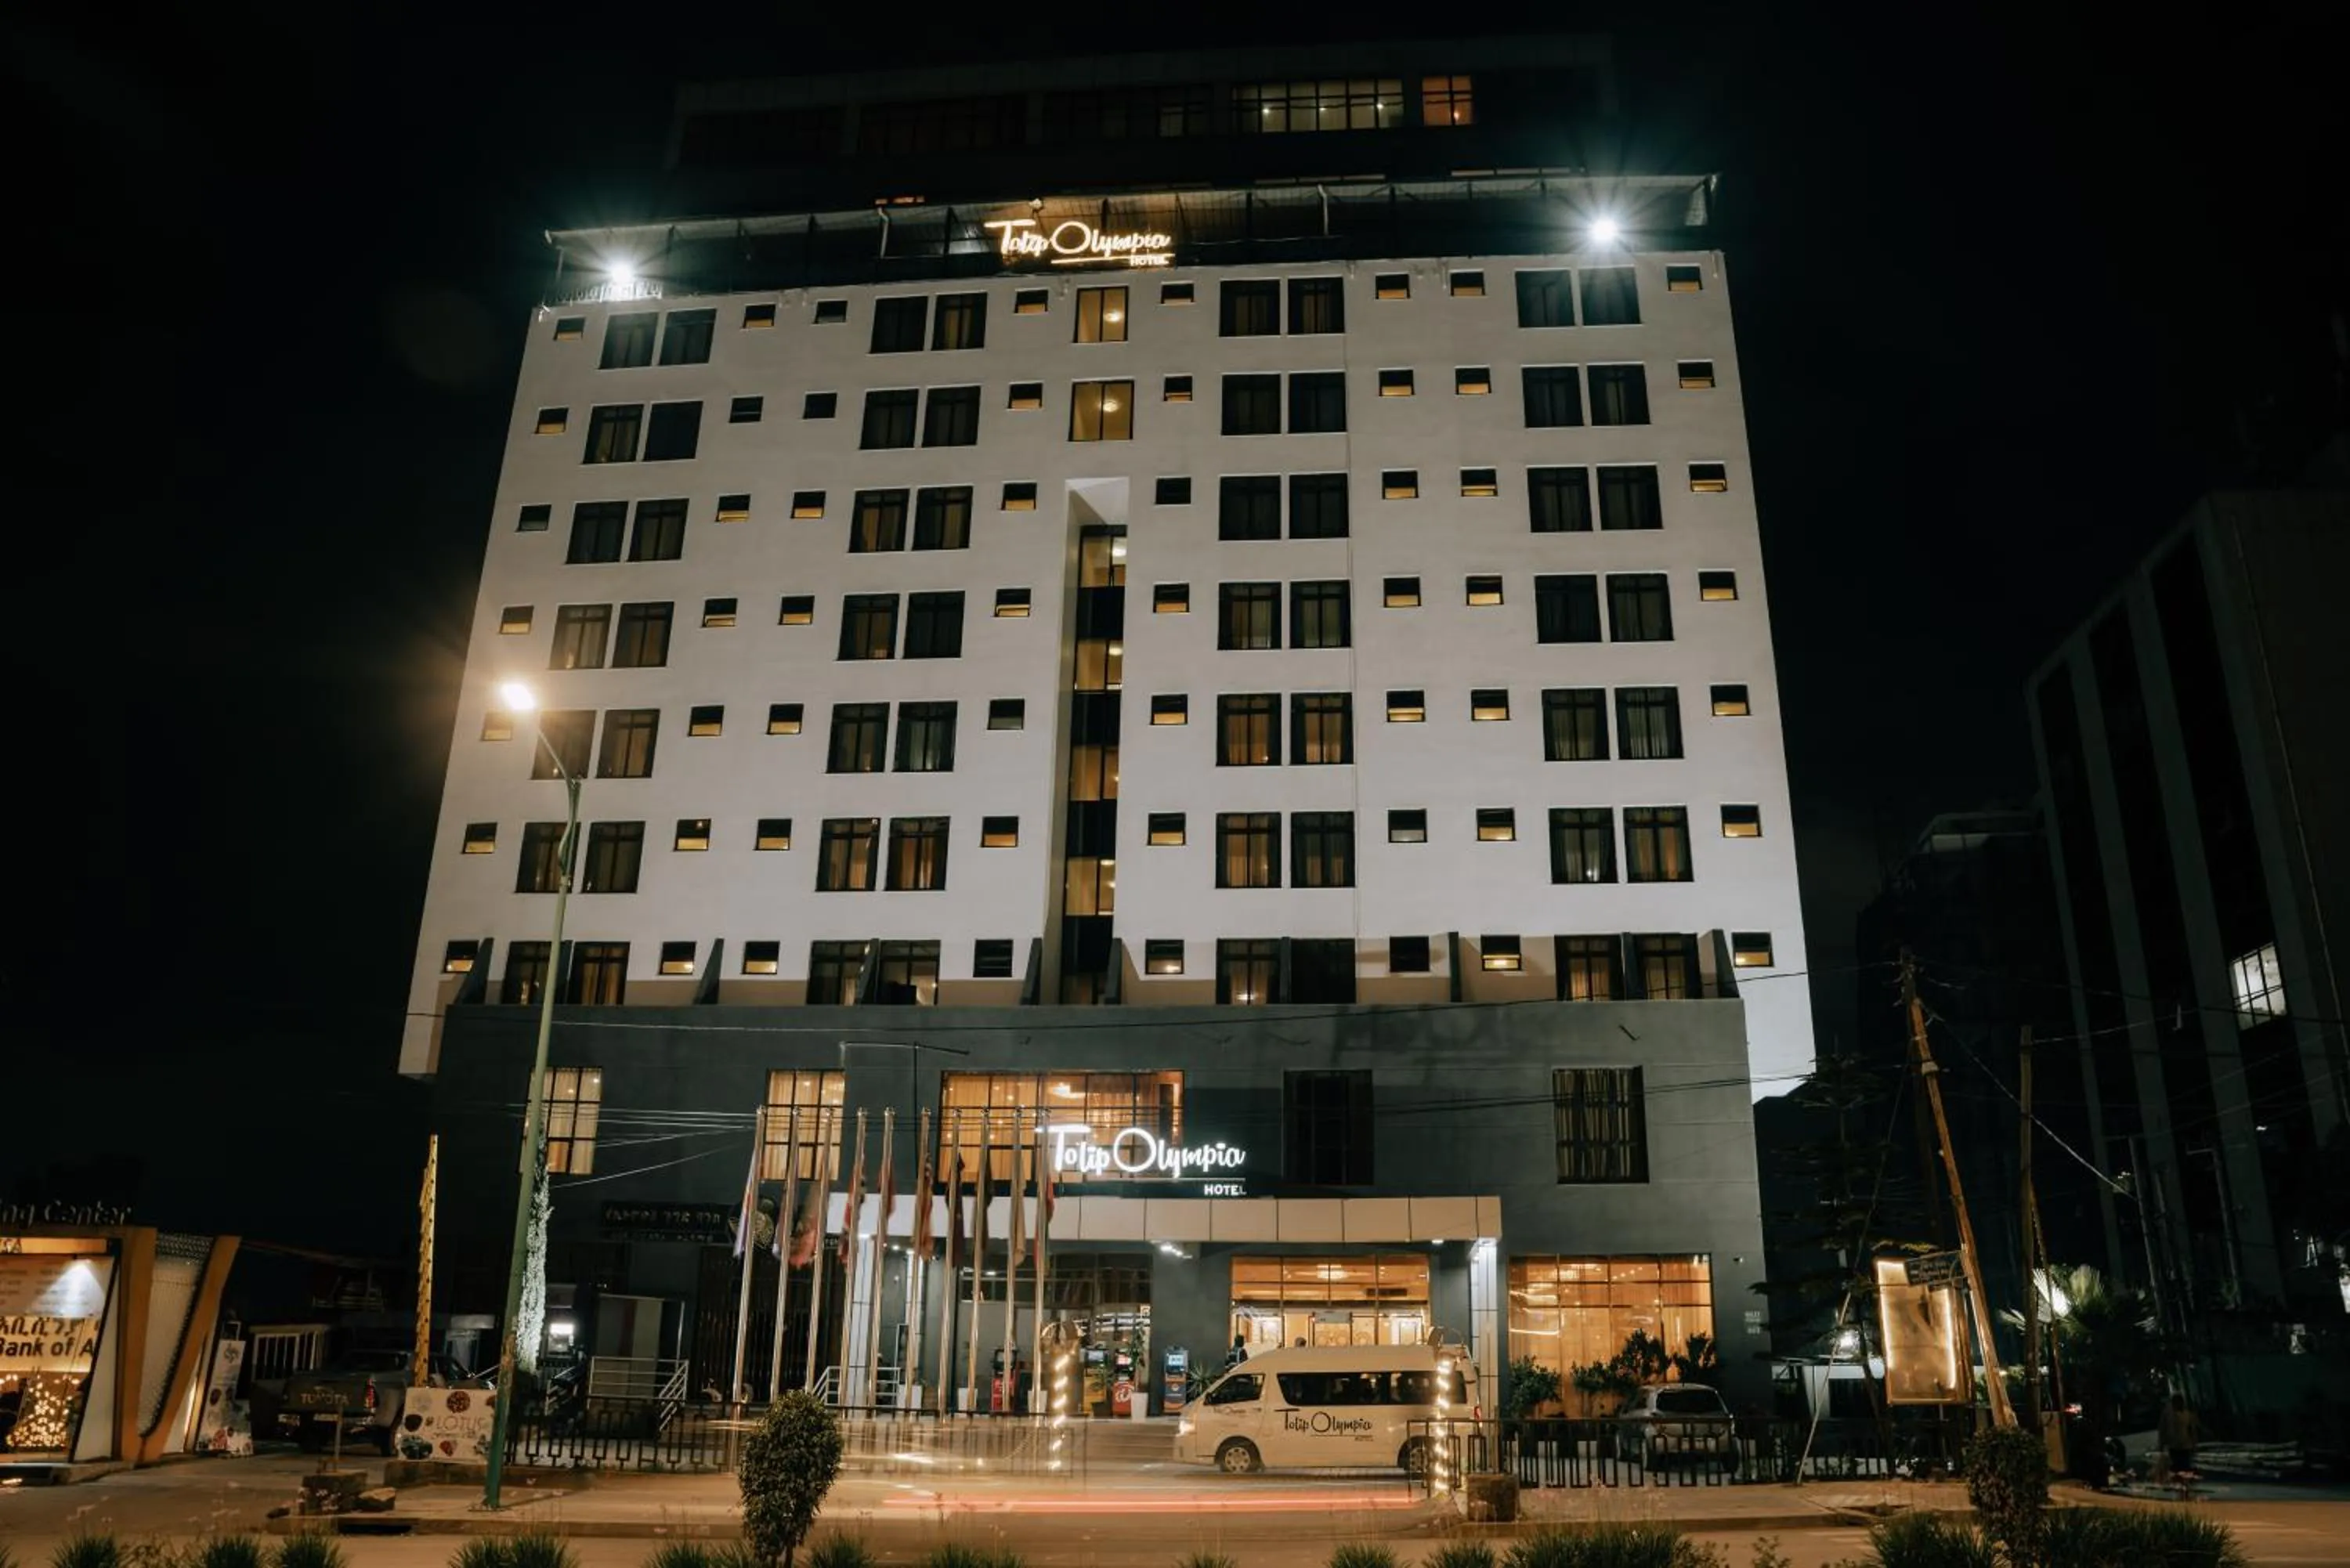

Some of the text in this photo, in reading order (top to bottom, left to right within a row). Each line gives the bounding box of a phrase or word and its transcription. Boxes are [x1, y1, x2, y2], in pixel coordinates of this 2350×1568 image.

[984, 219, 1171, 258] Tolip Olympia
[1035, 1124, 1246, 1179] Tolip Olympia
[1203, 1183, 1247, 1196] HOTEL
[50, 1336, 75, 1356] of
[1274, 1408, 1373, 1435] Tolip Olympia
